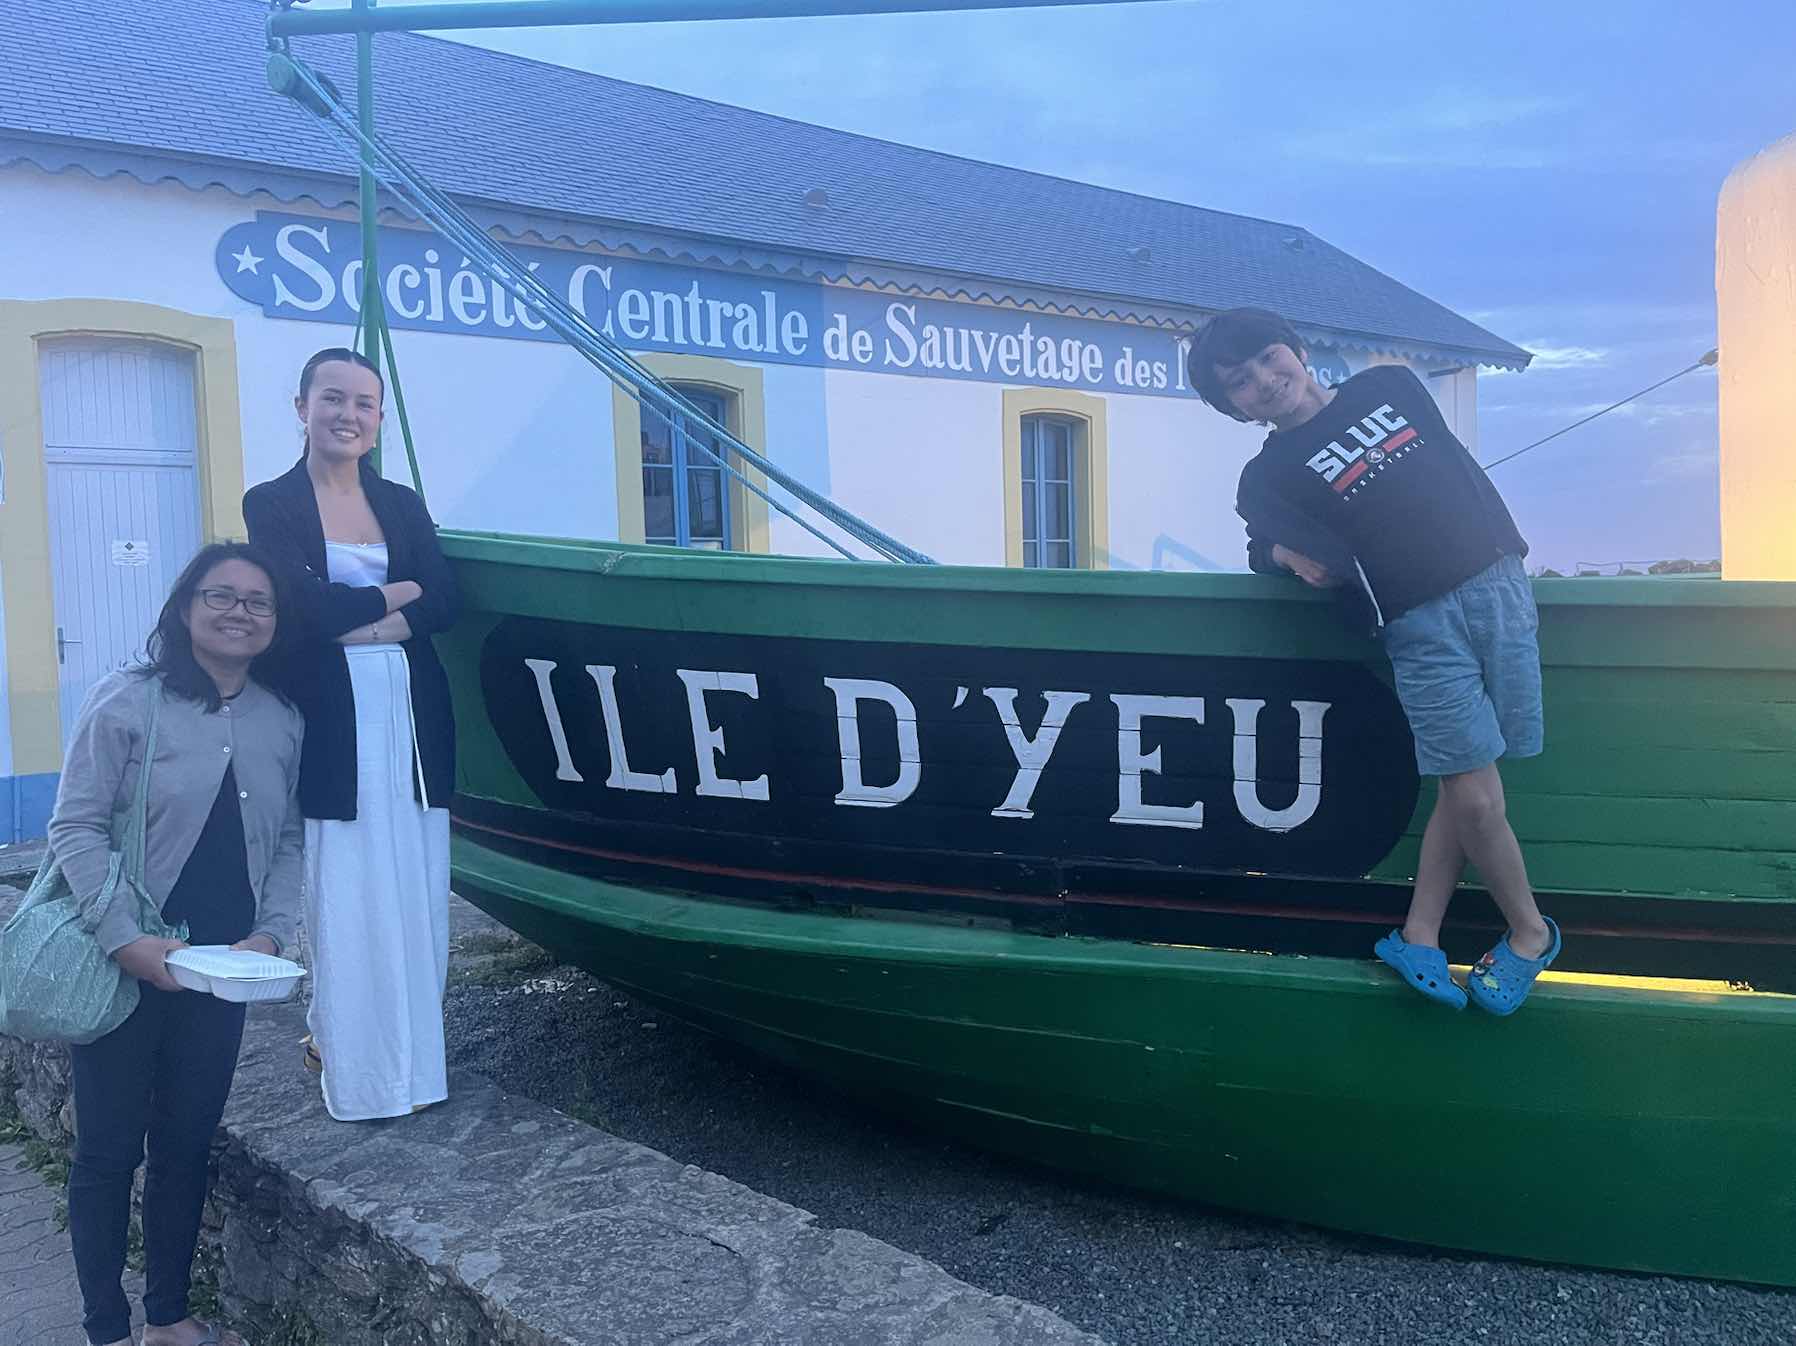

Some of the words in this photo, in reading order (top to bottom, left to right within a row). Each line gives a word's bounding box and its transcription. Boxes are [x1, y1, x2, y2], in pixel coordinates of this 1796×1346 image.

[568, 264, 809, 356] Centrale
[822, 313, 874, 364] de
[884, 302, 1104, 385] Sauvetage
[1114, 346, 1168, 390] des
[1305, 403, 1409, 483] SLUC
[524, 658, 770, 801] ILE
[823, 676, 1332, 833] D'YEU
